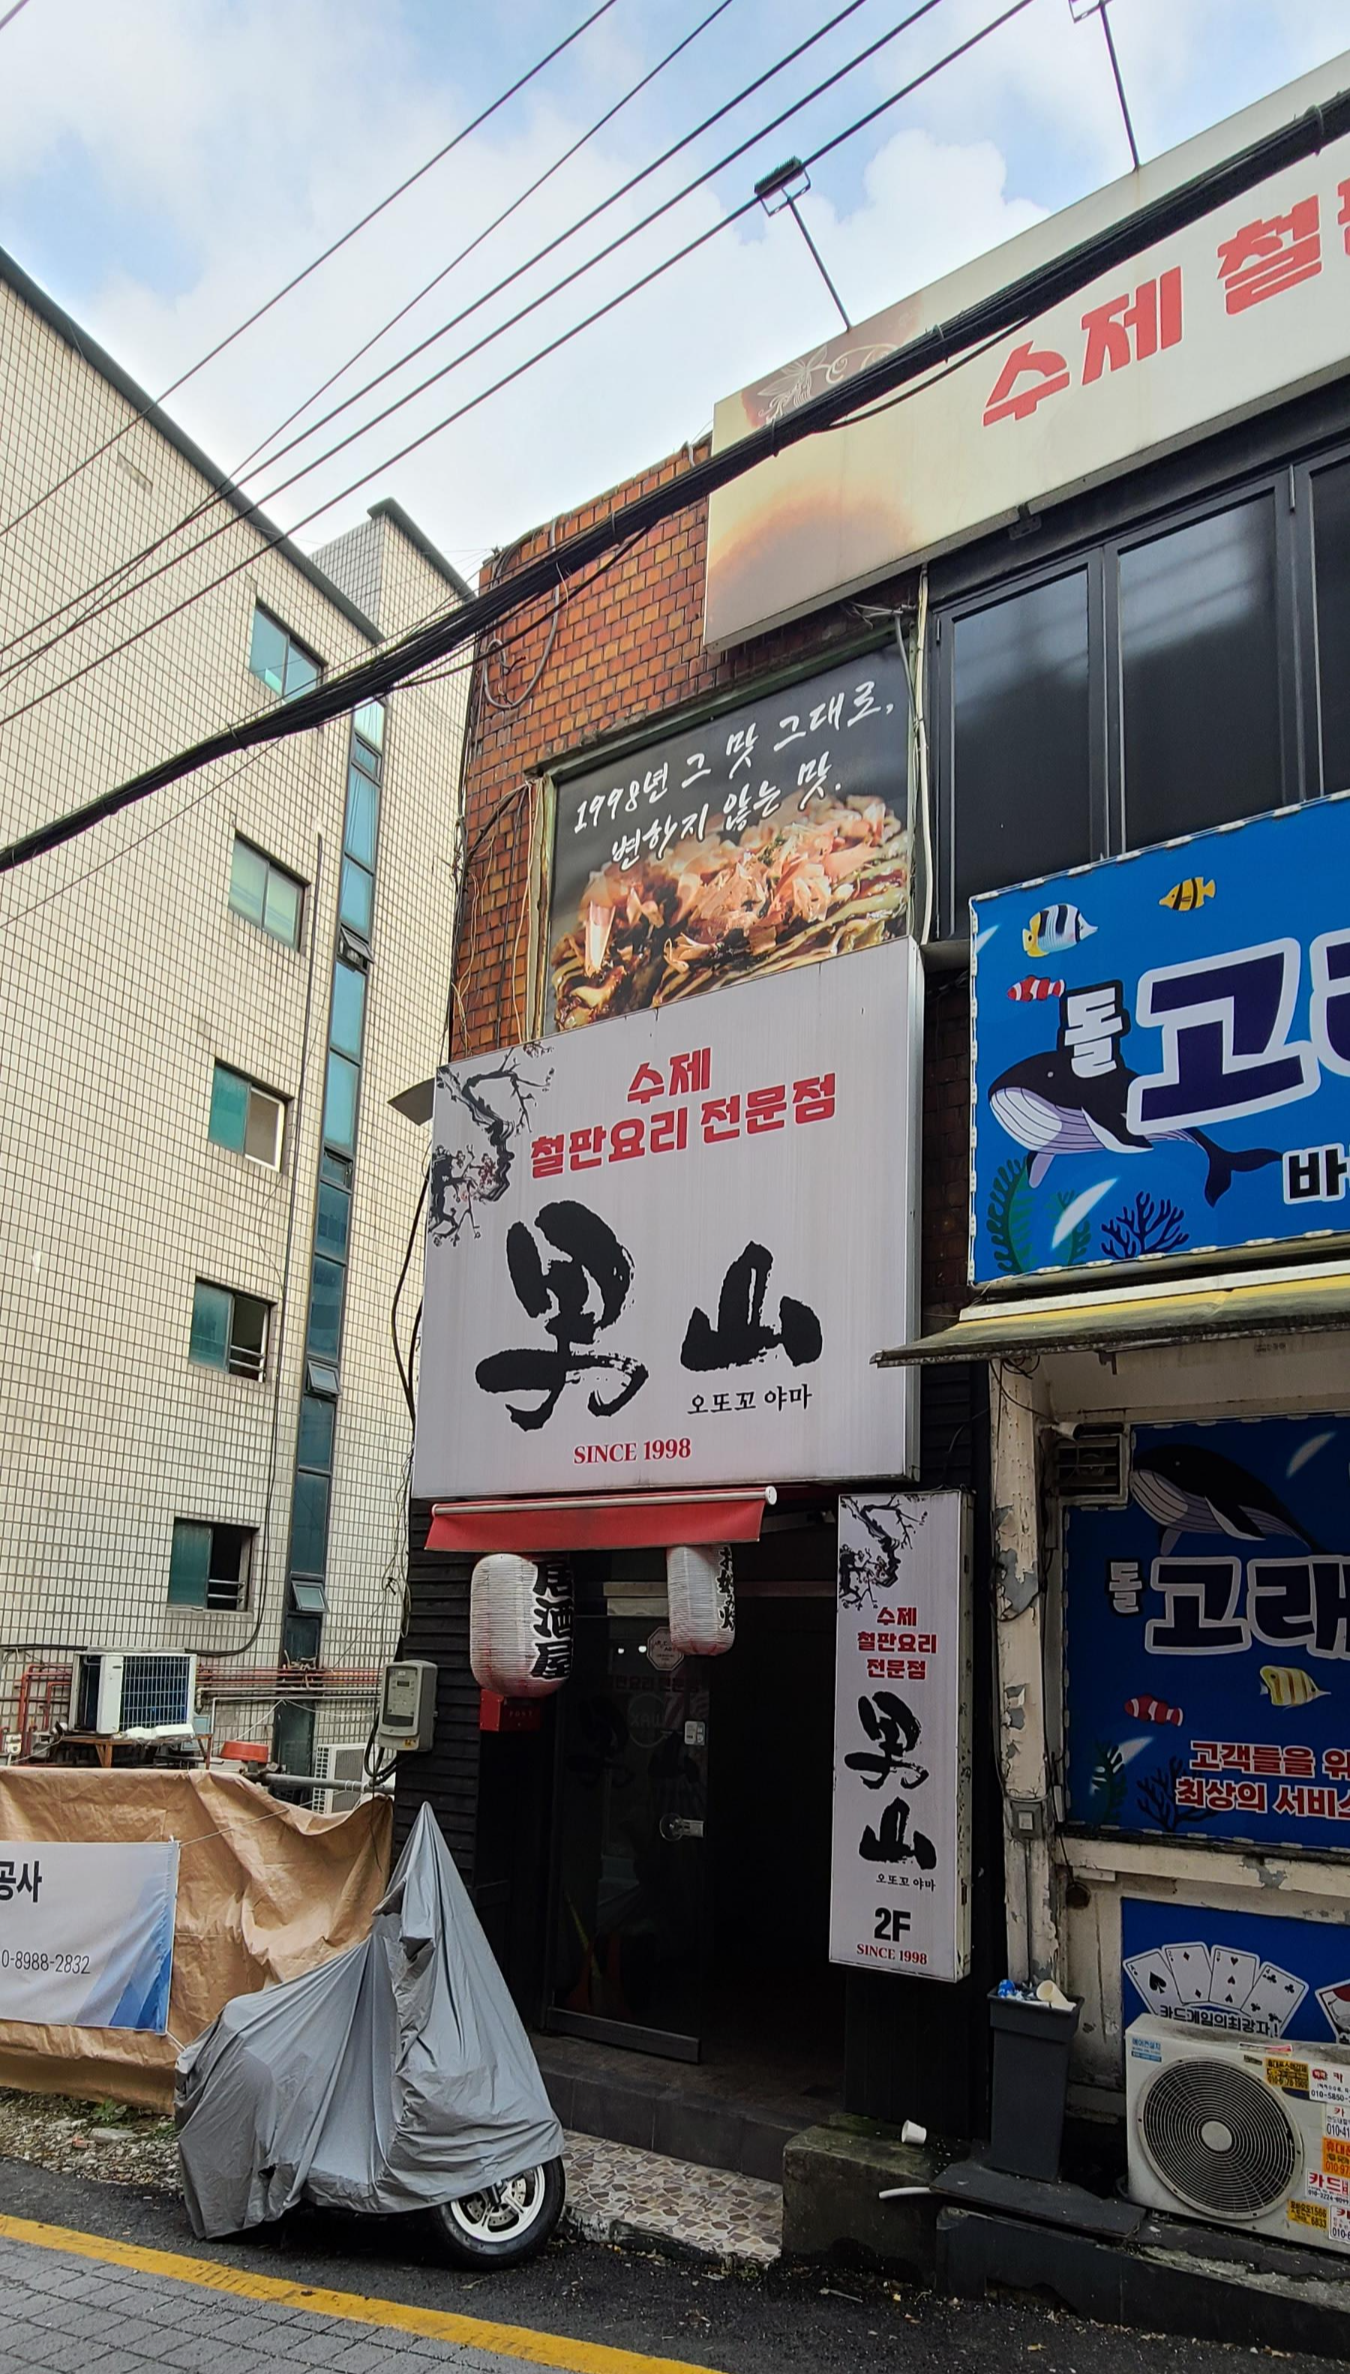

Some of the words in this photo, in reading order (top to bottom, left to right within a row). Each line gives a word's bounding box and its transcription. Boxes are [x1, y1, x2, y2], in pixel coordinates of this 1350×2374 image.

[983, 266, 1182, 426] 수제
[574, 763, 668, 833] 1998년
[682, 753, 711, 788] 그
[725, 723, 759, 779] 맛
[774, 681, 894, 751] 그대로,
[611, 803, 709, 871] 변하지
[723, 784, 781, 832] 않는
[797, 751, 842, 810] 맛.
[627, 1047, 712, 1104] 수제
[530, 1107, 688, 1179] 철판요리
[701, 1073, 836, 1144] 전문점
[687, 1395, 756, 1415] 오또꼬
[764, 1384, 813, 1411] 야마
[573, 1442, 637, 1465] SINCE
[642, 1437, 691, 1461] 1998
[876, 1606, 917, 1626] 수제
[857, 1631, 937, 1654] 철판요리
[866, 1658, 927, 1680] 전문점
[1190, 1740, 1316, 1779] 고객들을
[1175, 1777, 1268, 1814] 최상의
[876, 1873, 910, 1887] 오또꼬
[913, 1877, 936, 1892] 야마
[874, 1907, 911, 1942] 2F
[1, 1950, 90, 1974] 0-8988-2832
[857, 1943, 895, 1960] SINCE
[899, 1949, 928, 1965] 1998
